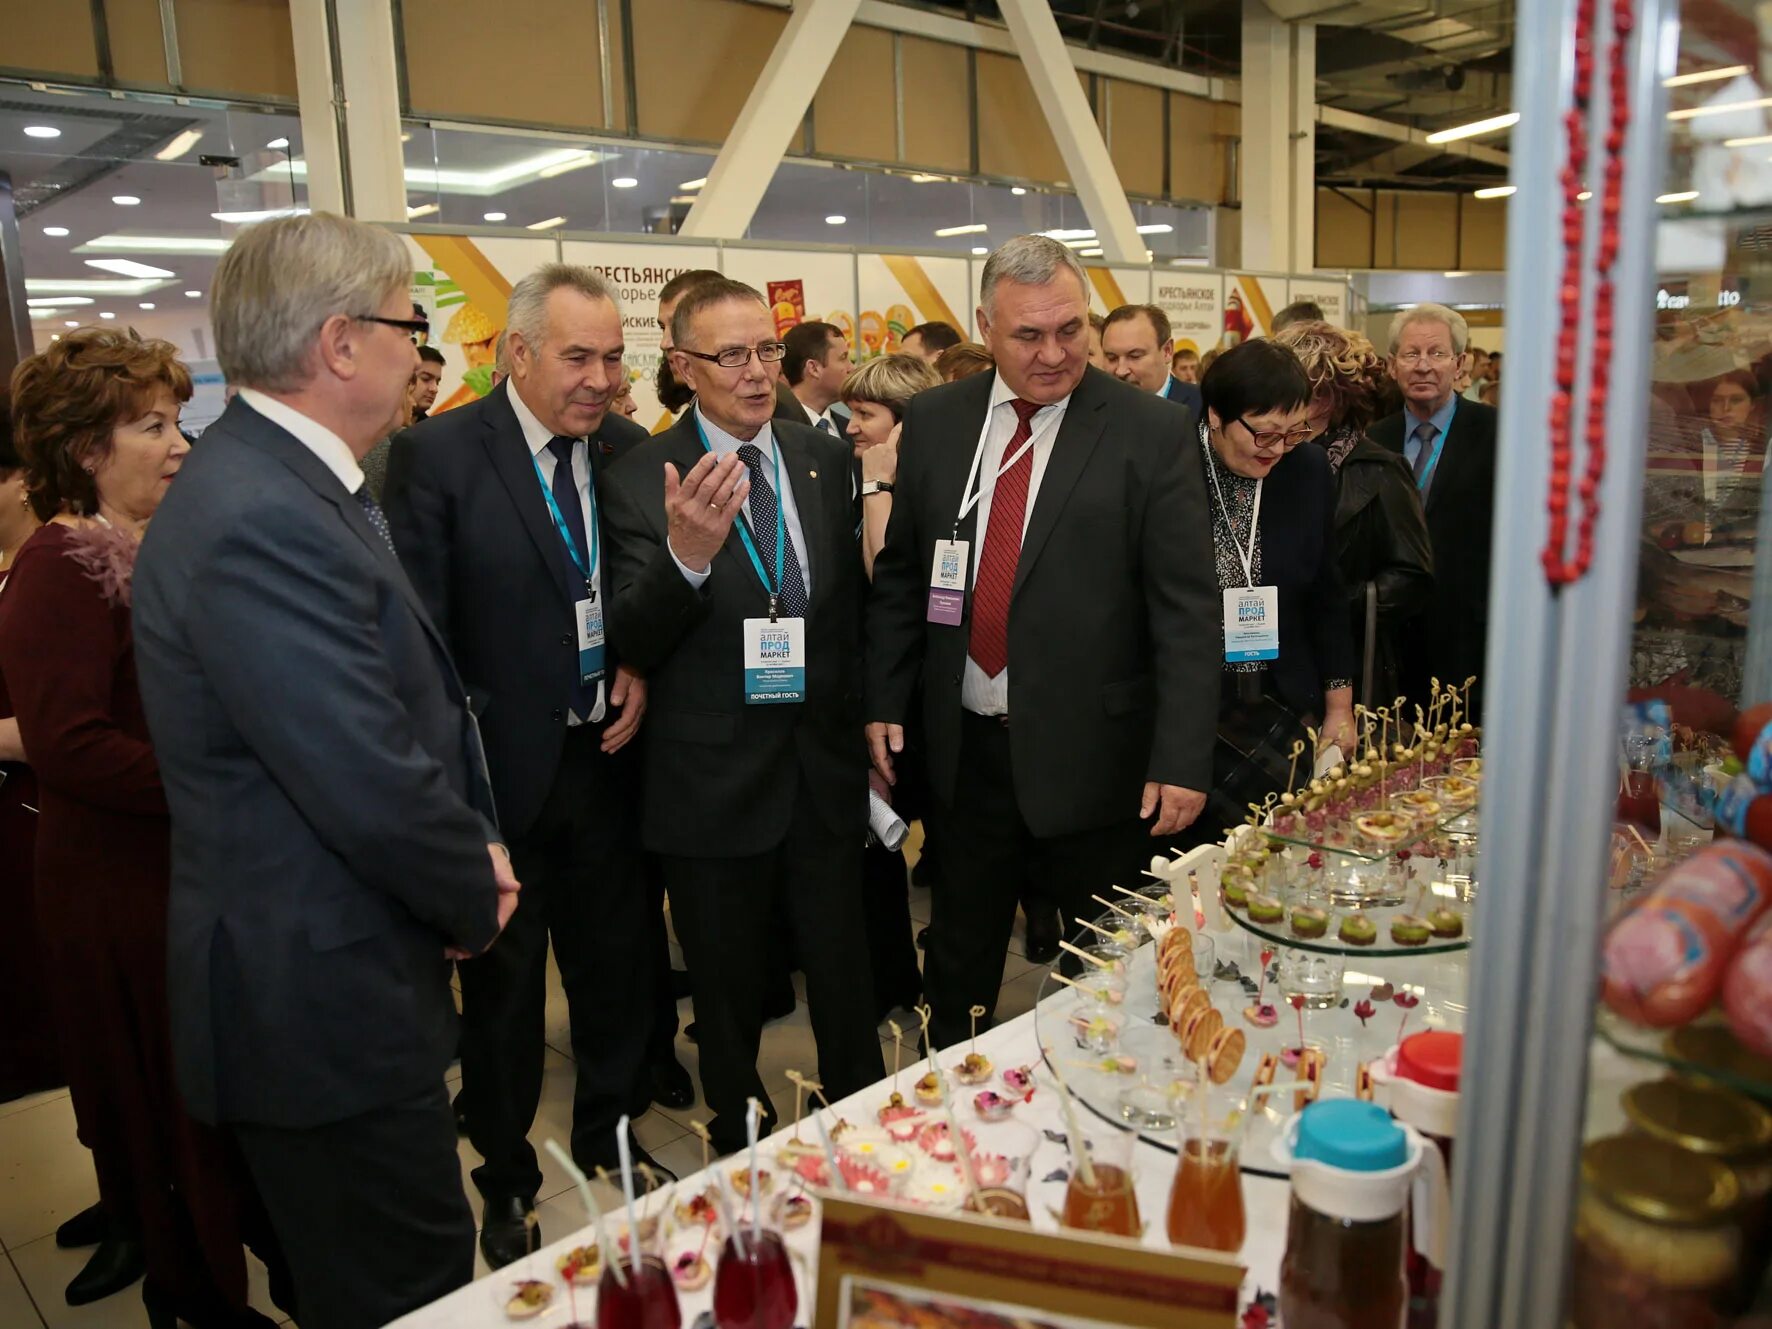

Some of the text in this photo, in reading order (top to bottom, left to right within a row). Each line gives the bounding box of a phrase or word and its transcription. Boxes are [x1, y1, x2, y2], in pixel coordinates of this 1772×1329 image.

[587, 266, 695, 284] РЕСТЬЯНСК
[616, 288, 657, 304] орье
[622, 313, 656, 328] ЙСКИЕ
[1238, 607, 1265, 617] ПРОД
[760, 641, 790, 652] ПРОД
[760, 651, 790, 659] МАРКЕТ
[782, 691, 800, 699] ГОСТЬ
